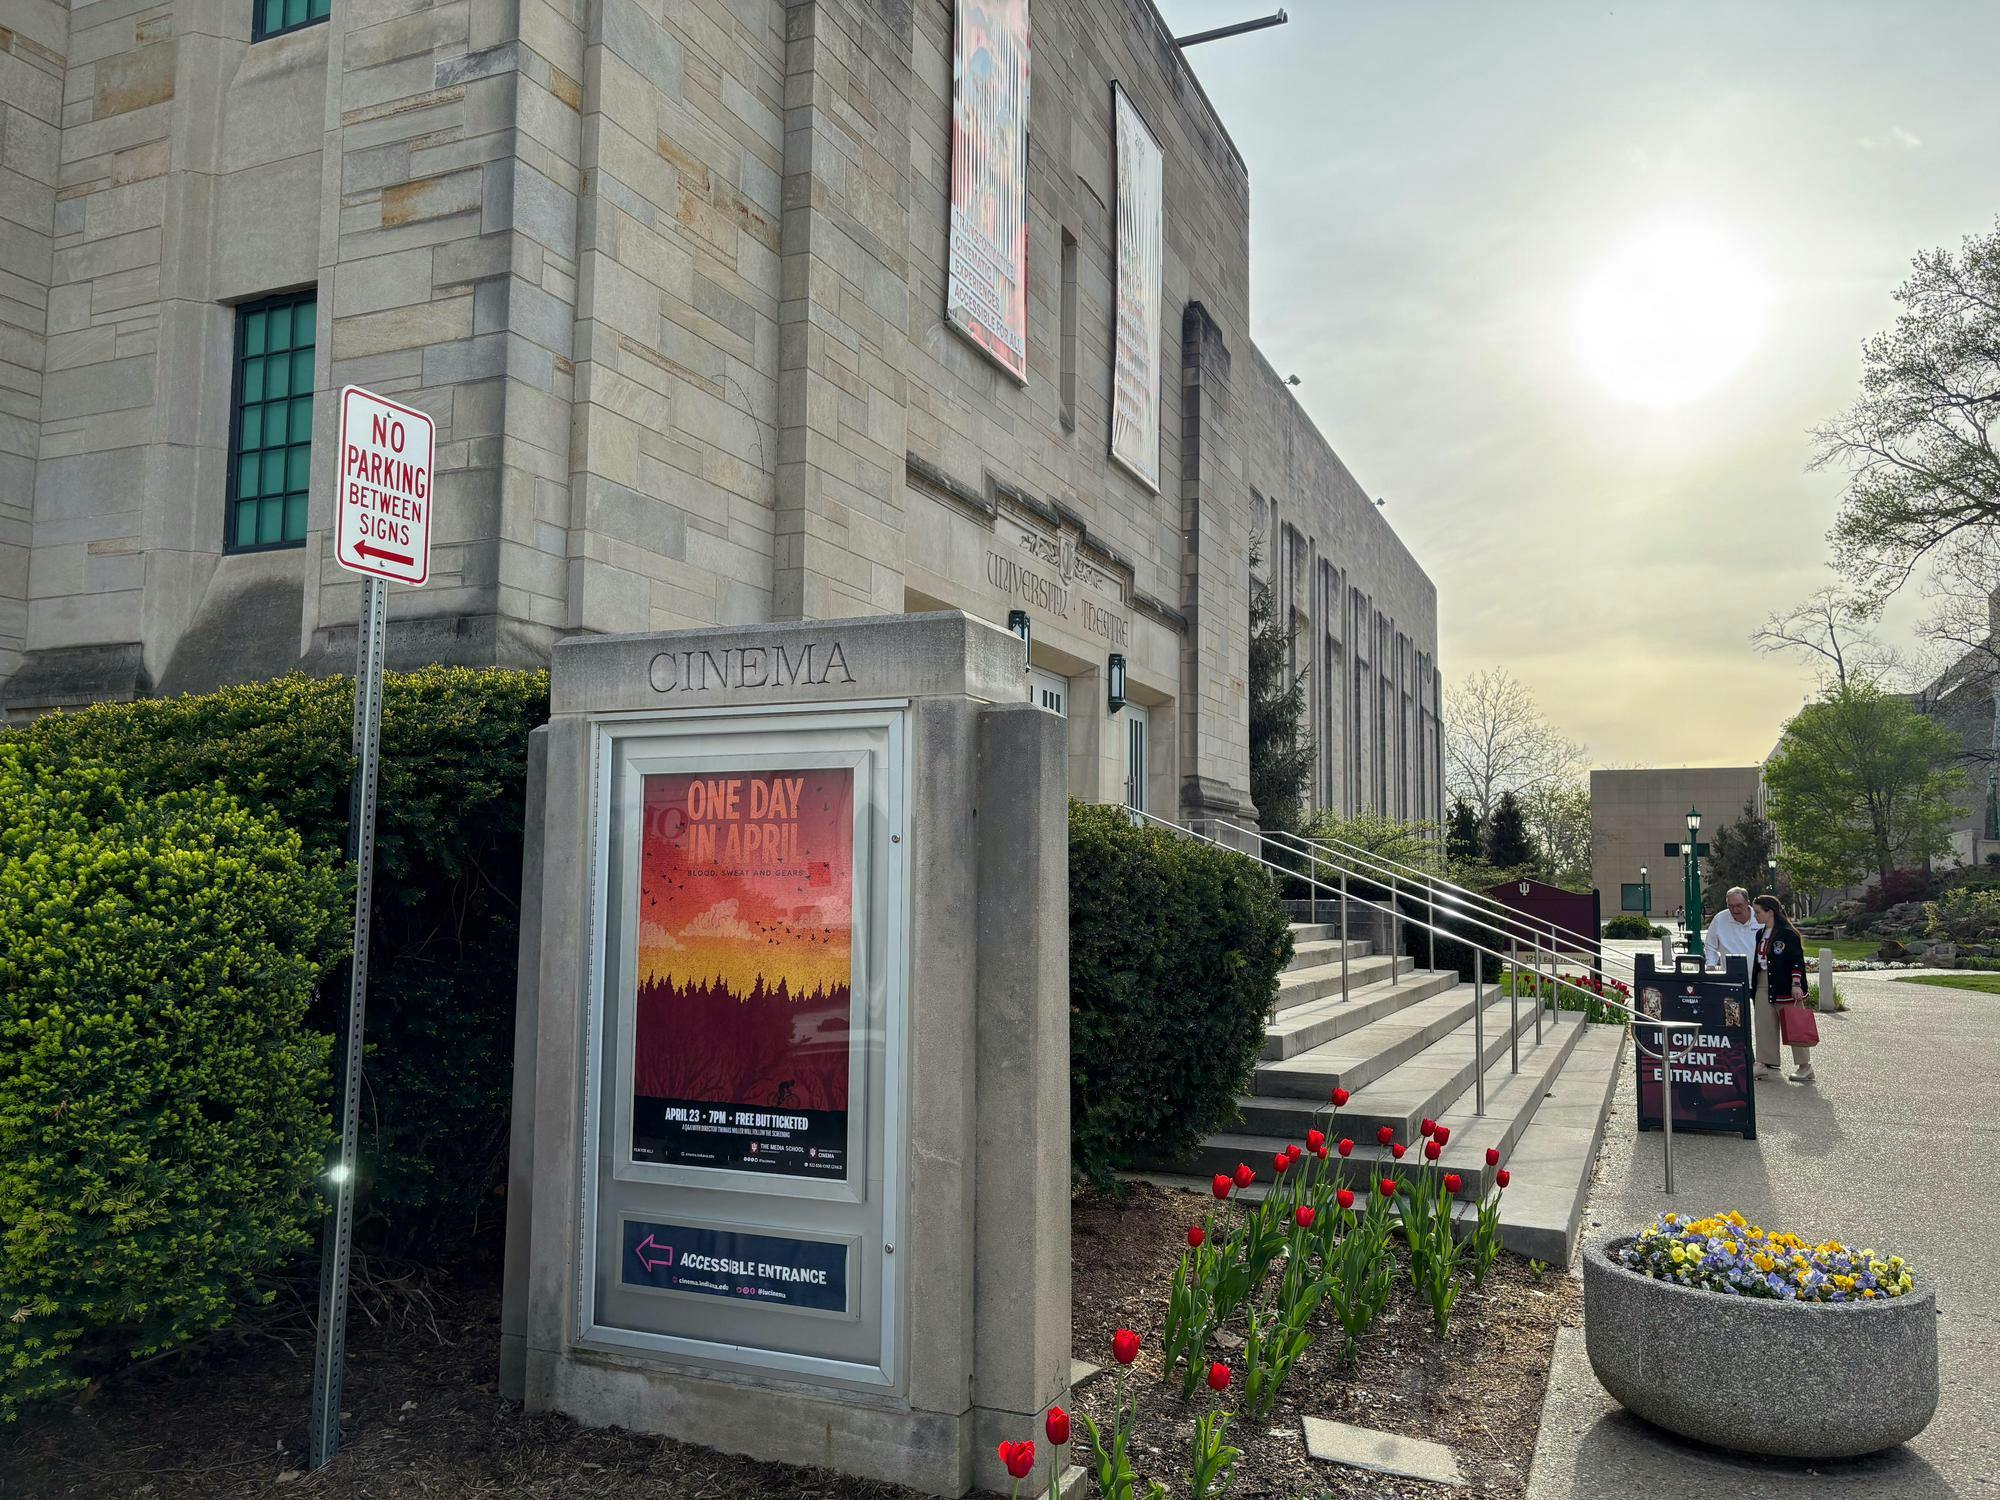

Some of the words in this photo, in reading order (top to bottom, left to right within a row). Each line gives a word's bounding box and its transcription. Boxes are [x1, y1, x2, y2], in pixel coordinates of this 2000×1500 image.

[955, 235, 992, 281] CINEMATIC
[955, 259, 1001, 311] EXPERIENCES
[954, 284, 996, 331] ACCESSIBLE
[995, 322, 1009, 343] FOR
[1009, 334, 1022, 354] ALL
[372, 413, 405, 453] NO
[348, 444, 426, 498] PARKING
[349, 482, 422, 523] BETWEEN
[359, 513, 410, 546] SIGNS
[986, 550, 1068, 620] UNIVERSITY
[649, 641, 857, 693] CINEMA
[687, 779, 742, 820] ONE
[750, 777, 804, 819] DAY
[687, 824, 716, 864] IN
[724, 823, 801, 864] APRIL
[687, 869, 718, 877] BLOOD,
[721, 869, 749, 877] SWEAT
[753, 869, 771, 877] AND
[1668, 1051, 1717, 1066] EVENT
[1672, 1033, 1731, 1048] CINEMA
[1653, 1068, 1734, 1085] ETRANCE
[665, 1107, 688, 1121] APRIL
[688, 1109, 700, 1122] 23
[708, 1110, 727, 1124] 7PM
[735, 1112, 754, 1126] FREE
[755, 1113, 772, 1128] BUT
[772, 1115, 809, 1131] TICKETED
[678, 1277, 729, 1291] cinema.indiana.edu
[757, 1288, 787, 1299] @iucinema
[680, 1252, 755, 1276] ACCESSIBLE
[758, 1263, 827, 1285] ENTRANCE
